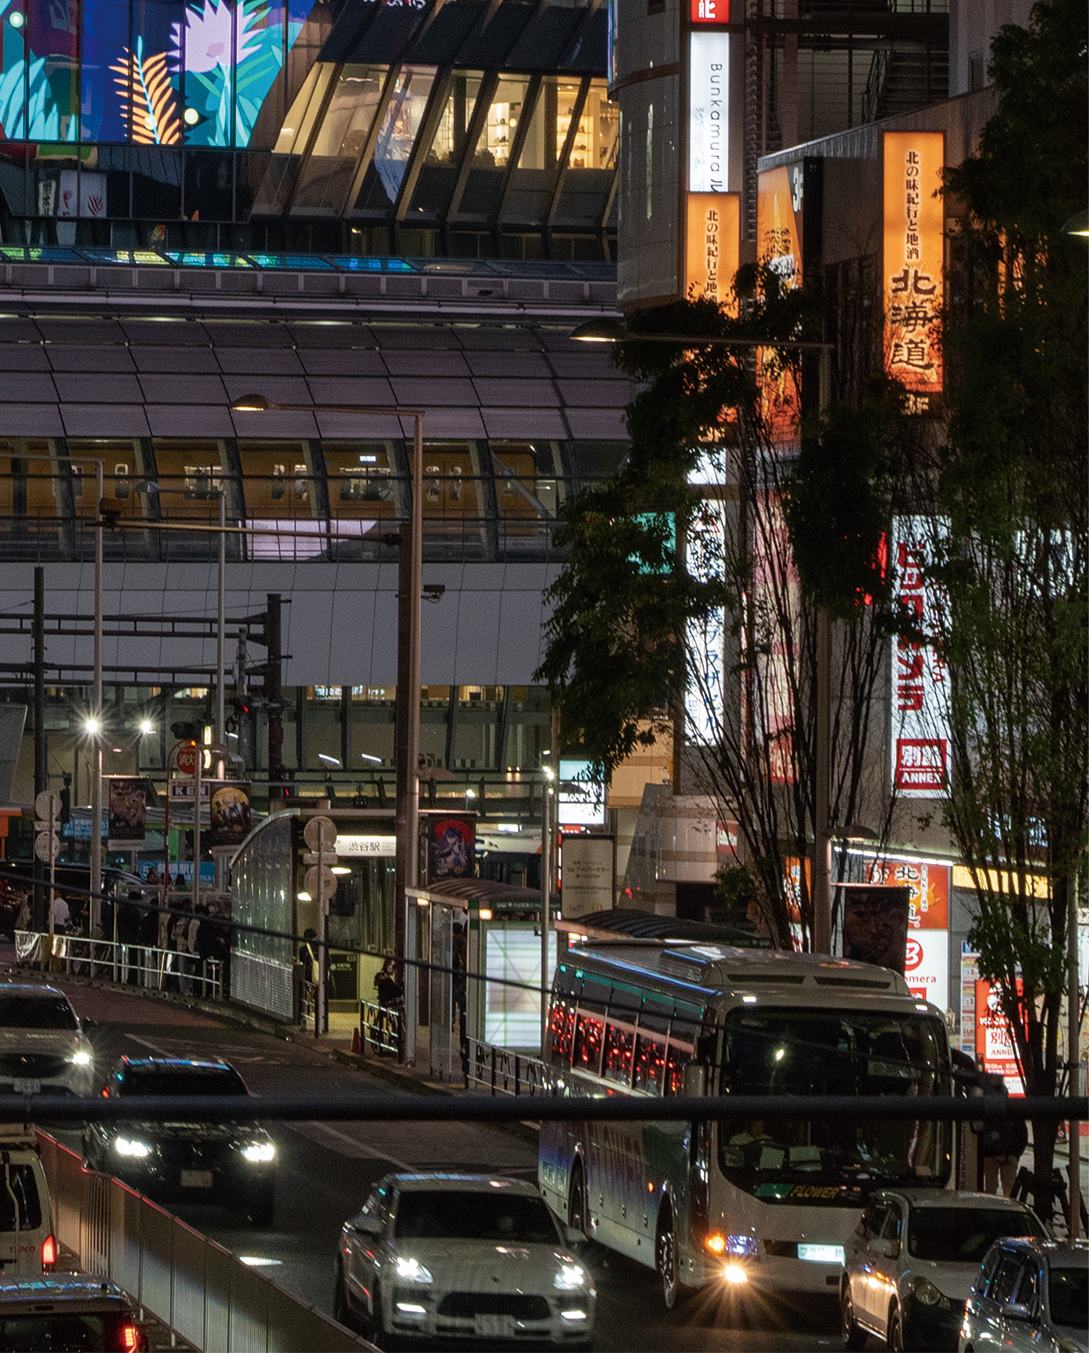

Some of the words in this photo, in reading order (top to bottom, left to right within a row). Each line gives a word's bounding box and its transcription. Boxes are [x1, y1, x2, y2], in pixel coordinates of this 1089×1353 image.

[710, 63, 723, 172] Bunkamura
[906, 151, 919, 260] 北の味紀行と地酒
[891, 269, 937, 371] 北海道
[898, 542, 923, 710] ビックメラ
[348, 841, 381, 852] 渋谷駅
[904, 975, 937, 983] amera
[790, 1185, 840, 1198] FLOWER
